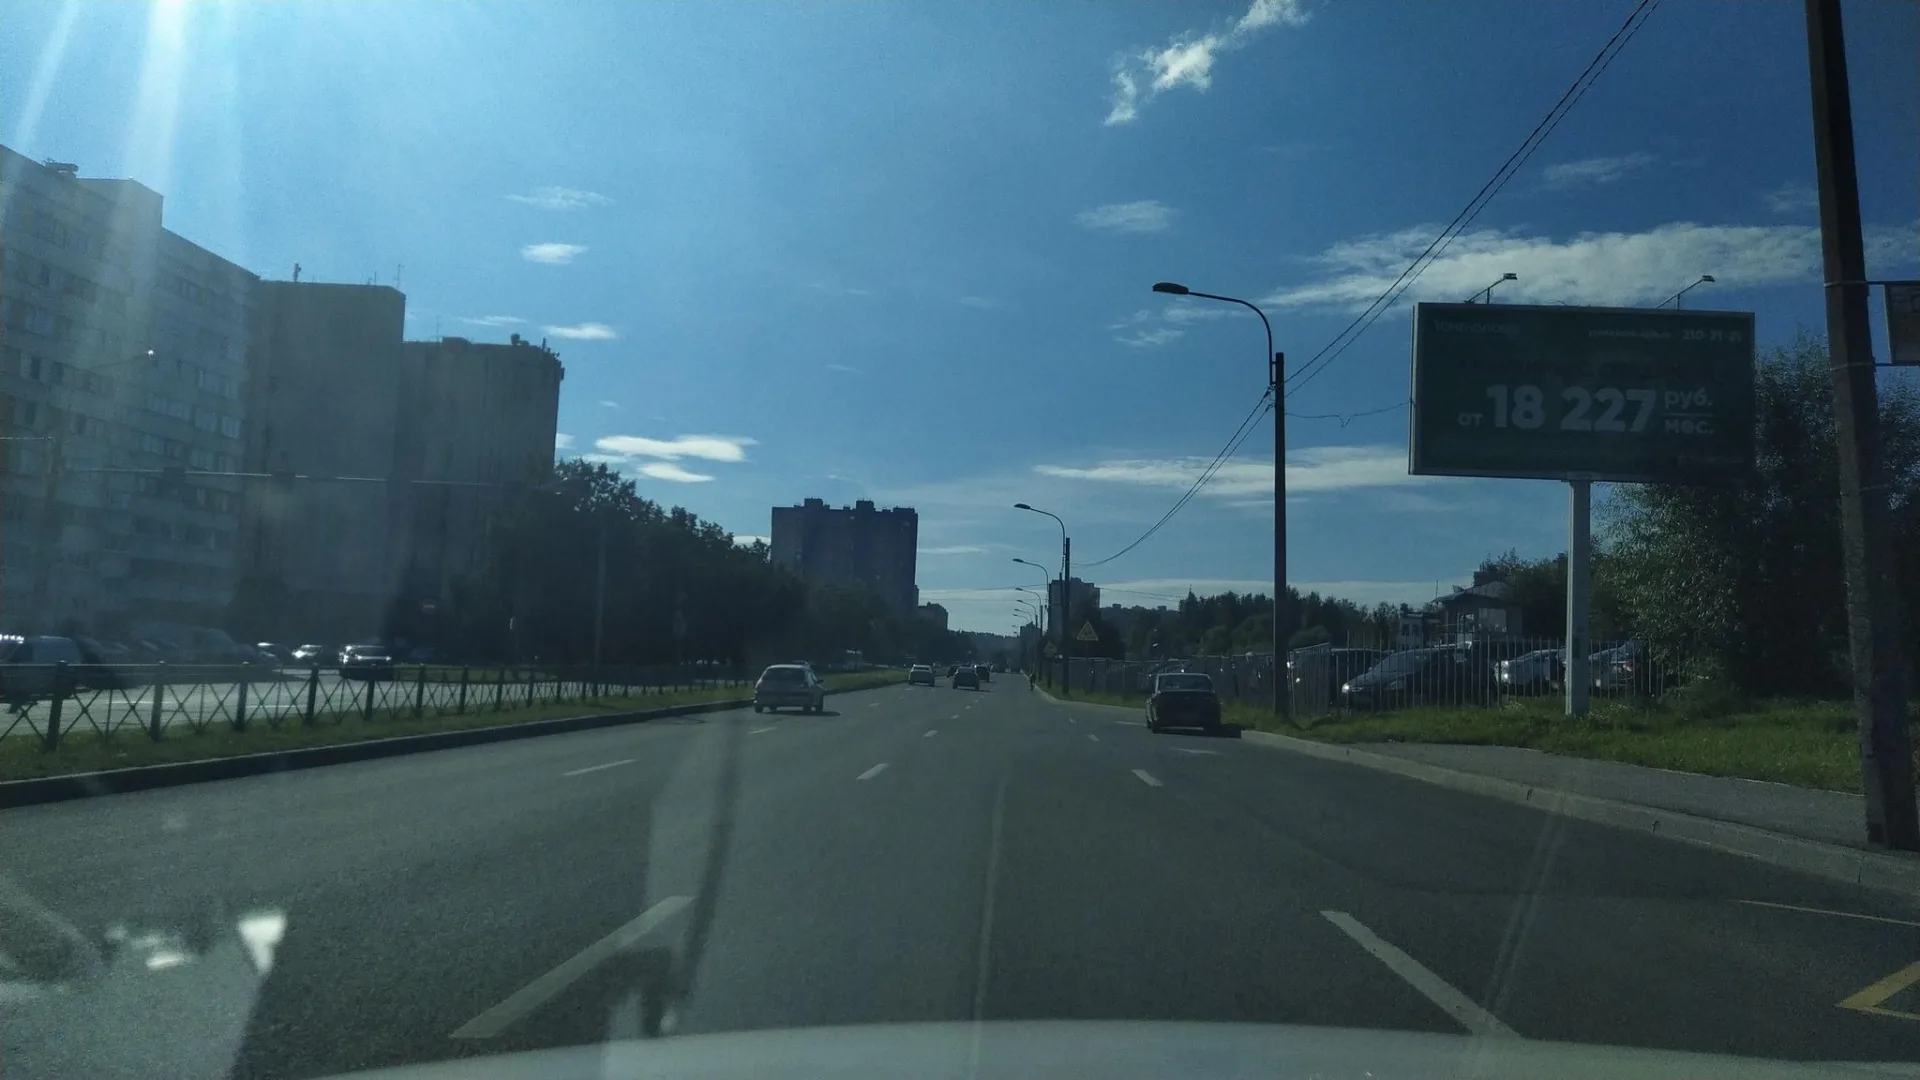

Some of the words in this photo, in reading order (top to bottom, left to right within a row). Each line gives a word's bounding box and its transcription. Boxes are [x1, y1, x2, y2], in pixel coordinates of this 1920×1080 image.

[1485, 385, 1546, 430] 18
[1560, 386, 1657, 433] 227
[1664, 388, 1714, 410] руб.
